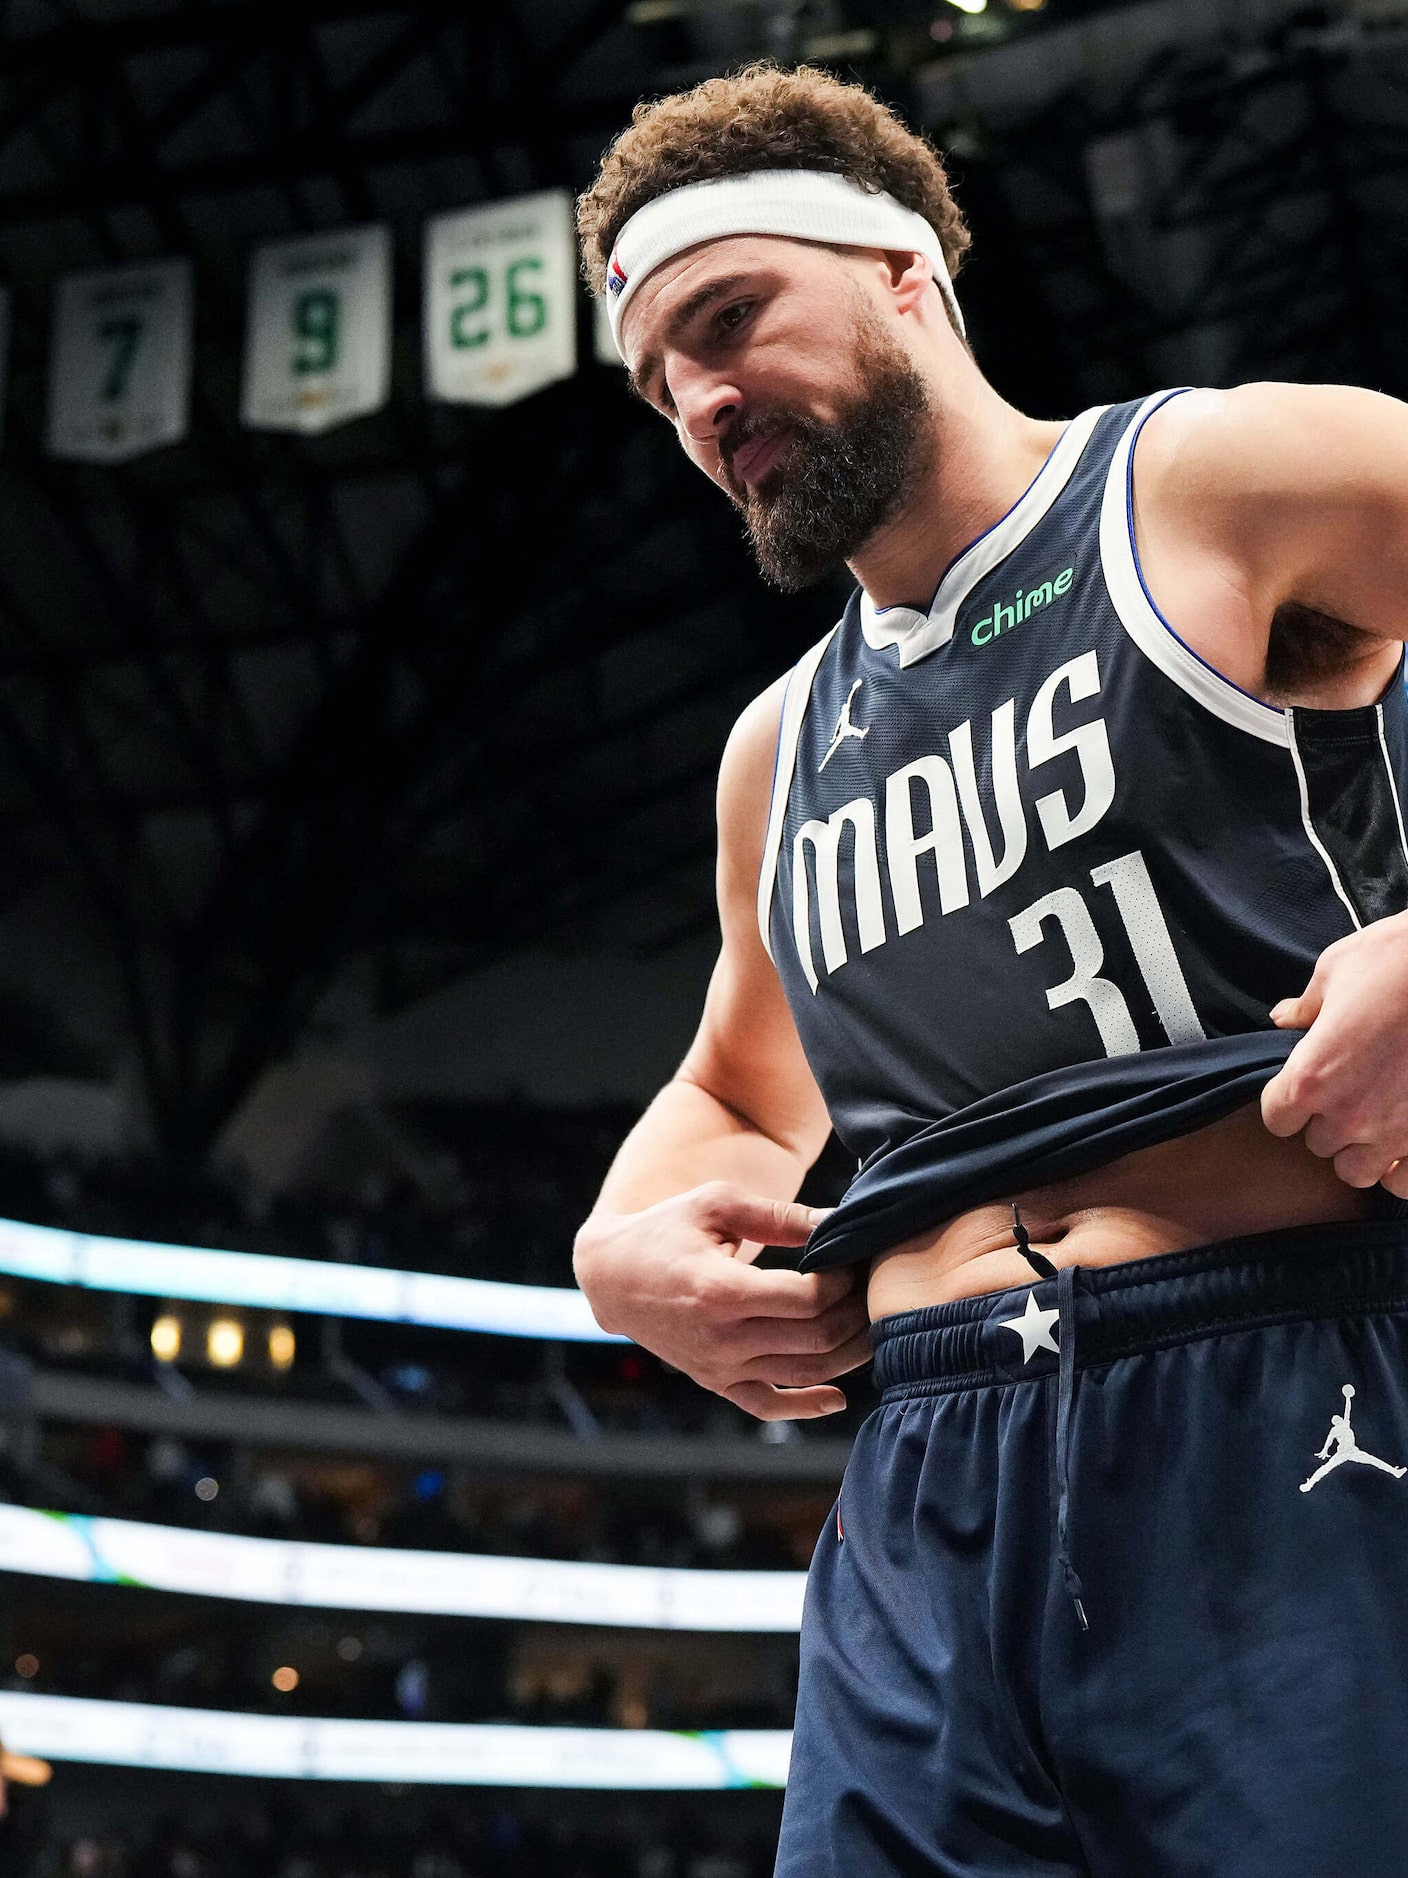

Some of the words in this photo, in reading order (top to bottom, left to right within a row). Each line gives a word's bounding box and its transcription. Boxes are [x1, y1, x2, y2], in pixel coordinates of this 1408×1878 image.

[293, 288, 339, 375] 9
[449, 258, 547, 351] 26
[98, 317, 143, 401] 7
[972, 567, 1074, 646] chime
[793, 650, 1116, 996] MAVS
[1008, 850, 1207, 1058] 31
